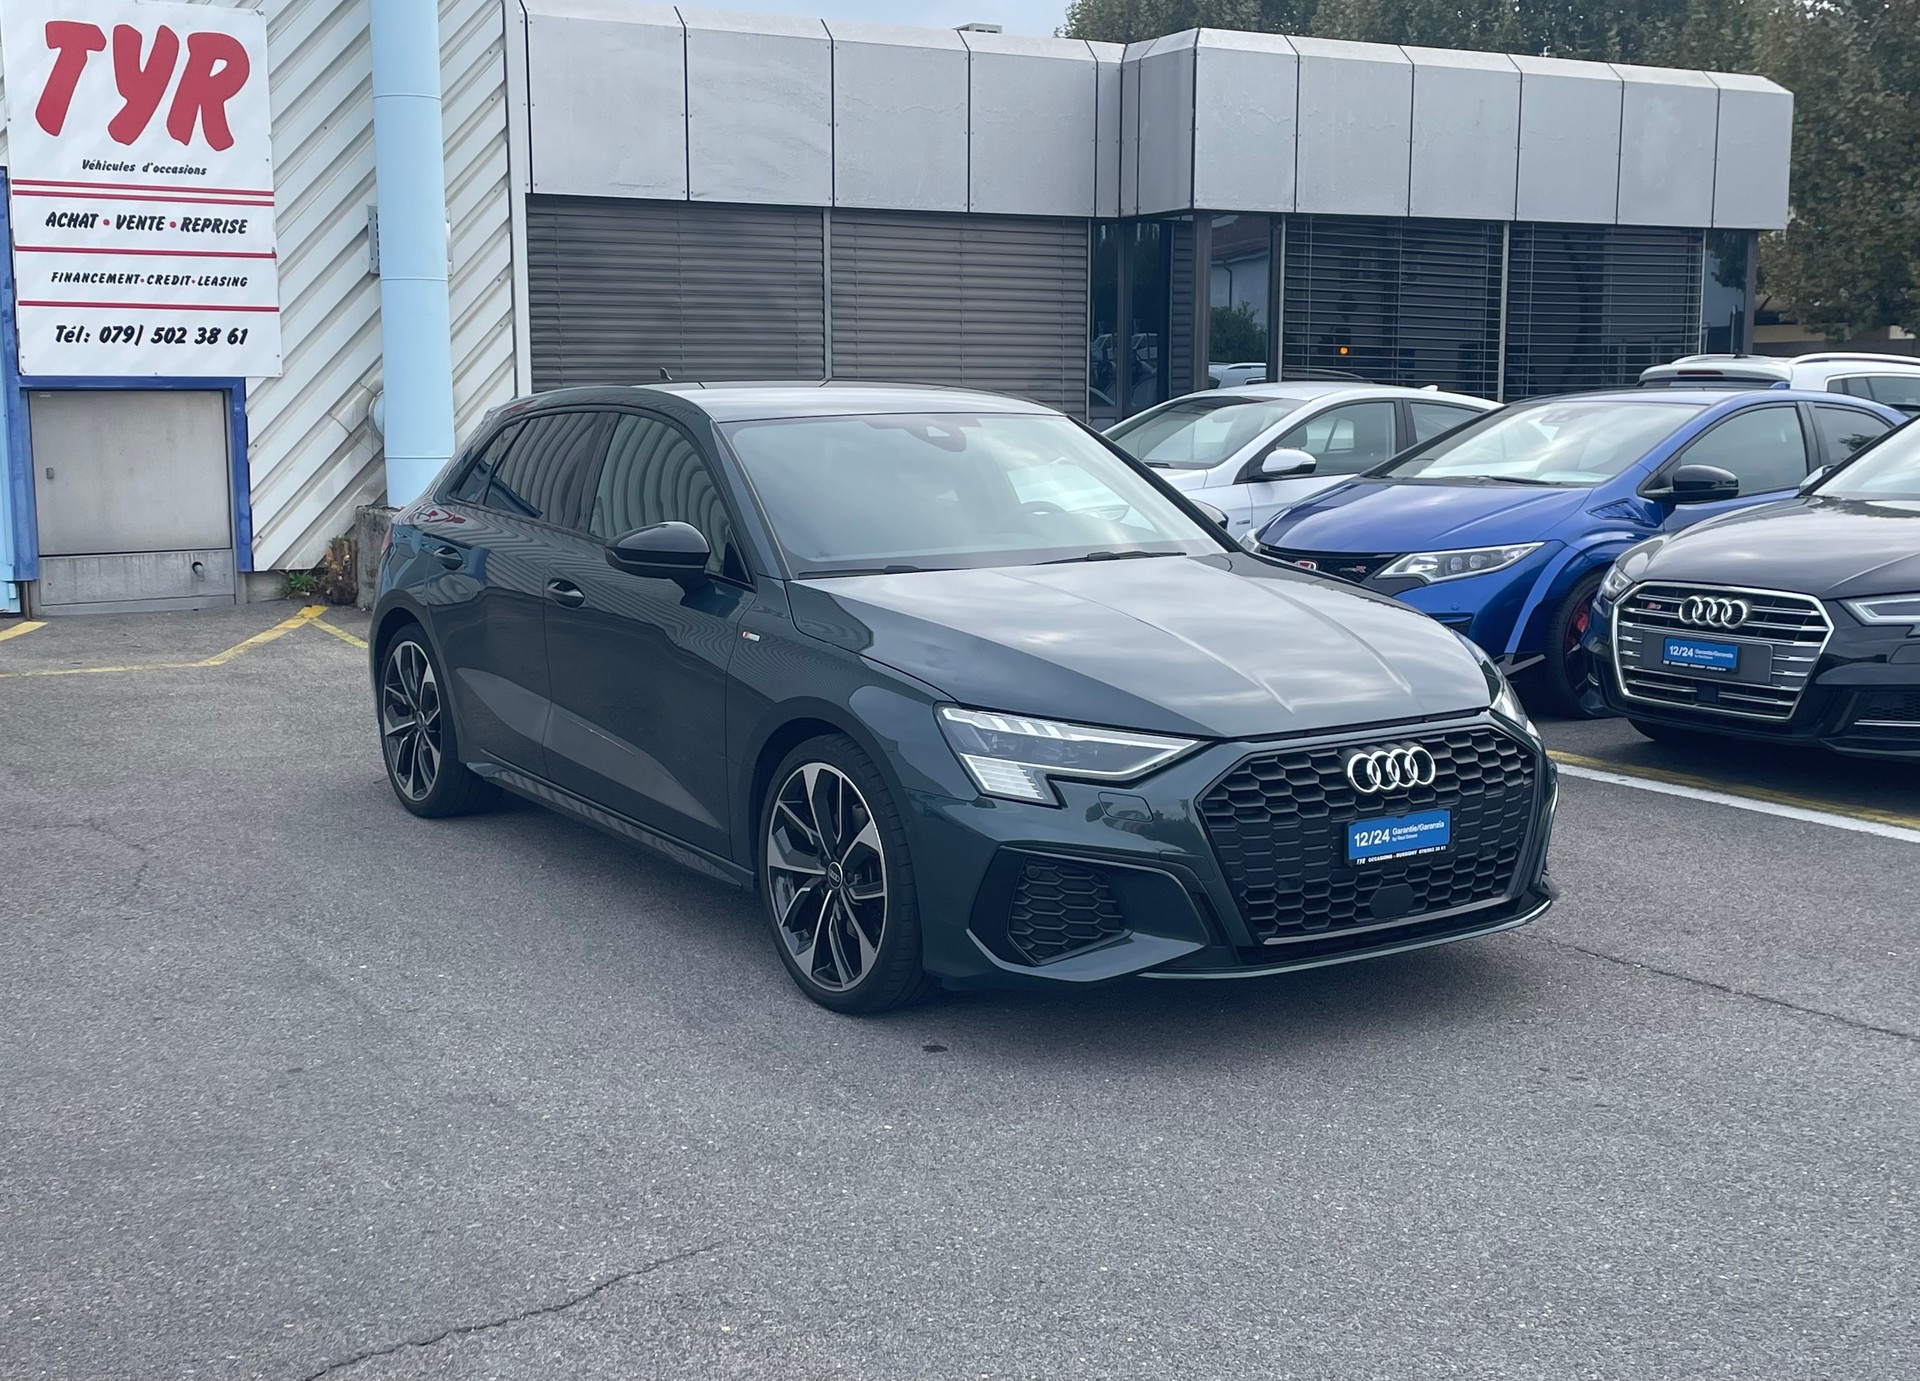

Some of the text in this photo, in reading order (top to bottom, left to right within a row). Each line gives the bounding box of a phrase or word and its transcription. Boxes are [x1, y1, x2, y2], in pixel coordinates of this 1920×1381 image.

[36, 21, 250, 151] TYR
[81, 159, 207, 175] Véhicules d'occasions
[45, 211, 248, 234] ACHAT VENTE REPRISE
[51, 272, 248, 287] FINANCEMENT CREDIT LEASING
[55, 325, 91, 343] Tél:
[150, 327, 187, 344] 502
[194, 327, 222, 345] 38
[227, 328, 248, 345] 61
[1669, 645, 1694, 657] 12/24
[1354, 828, 1390, 847] 12/24
